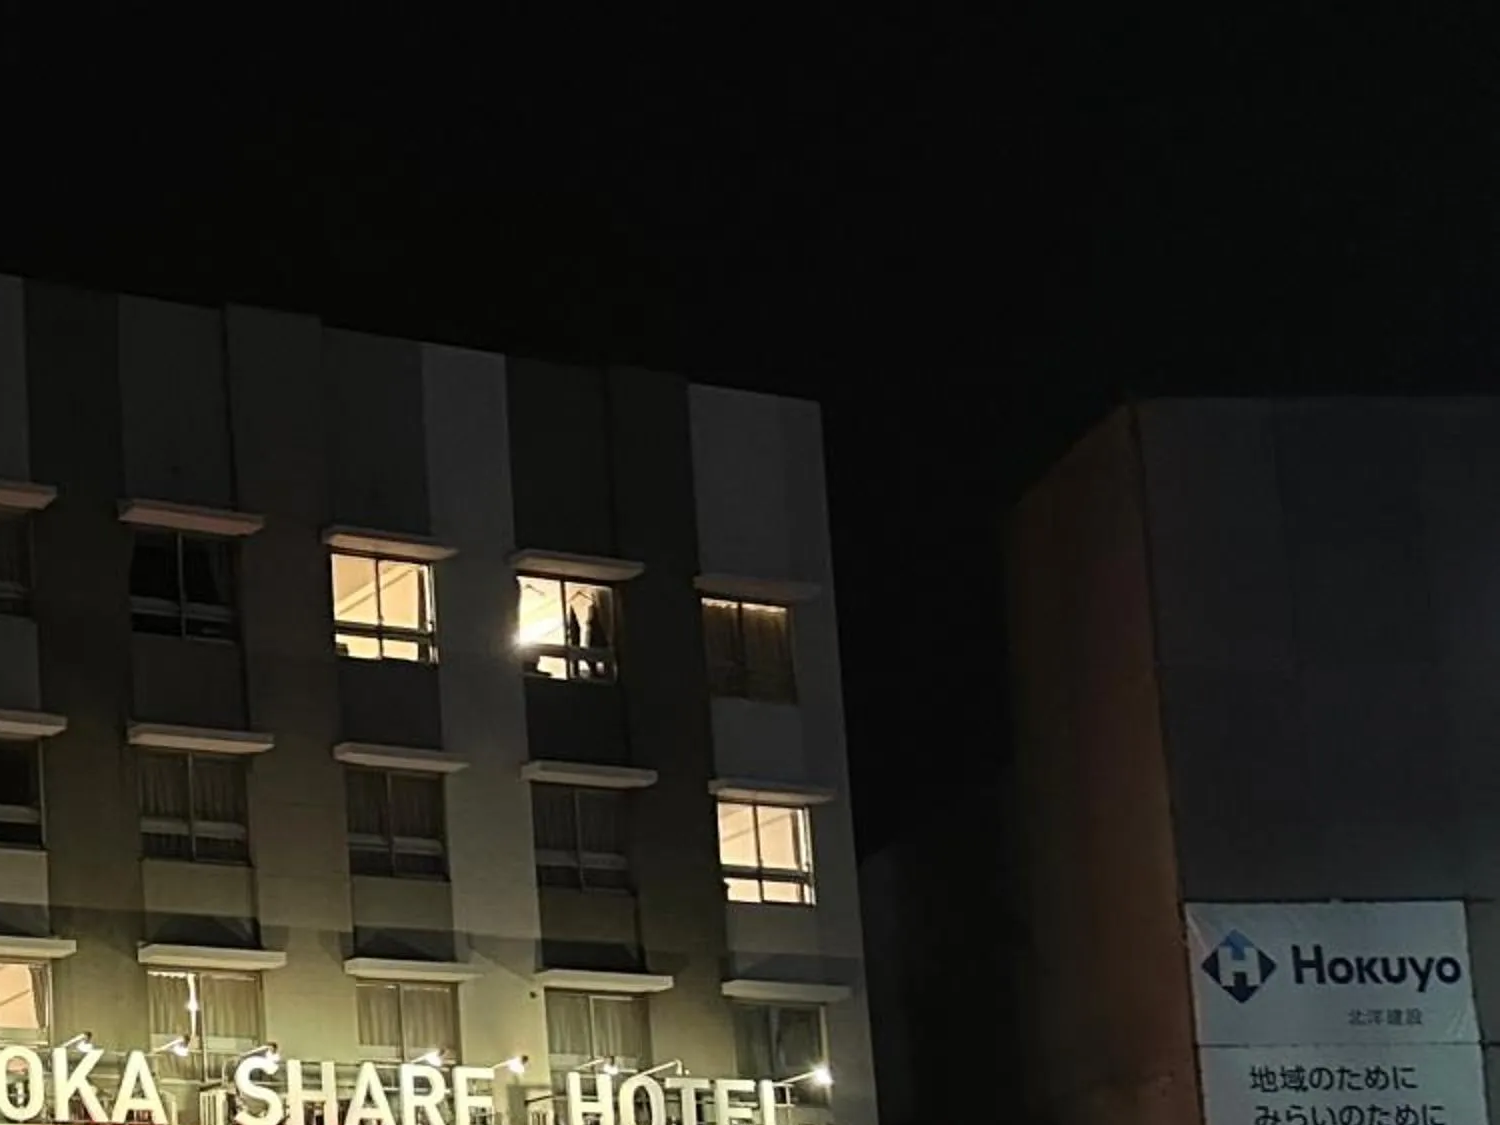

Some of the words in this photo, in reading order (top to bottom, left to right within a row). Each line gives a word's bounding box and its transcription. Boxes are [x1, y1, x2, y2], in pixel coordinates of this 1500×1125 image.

[1250, 1065, 1418, 1093] 地域のために
